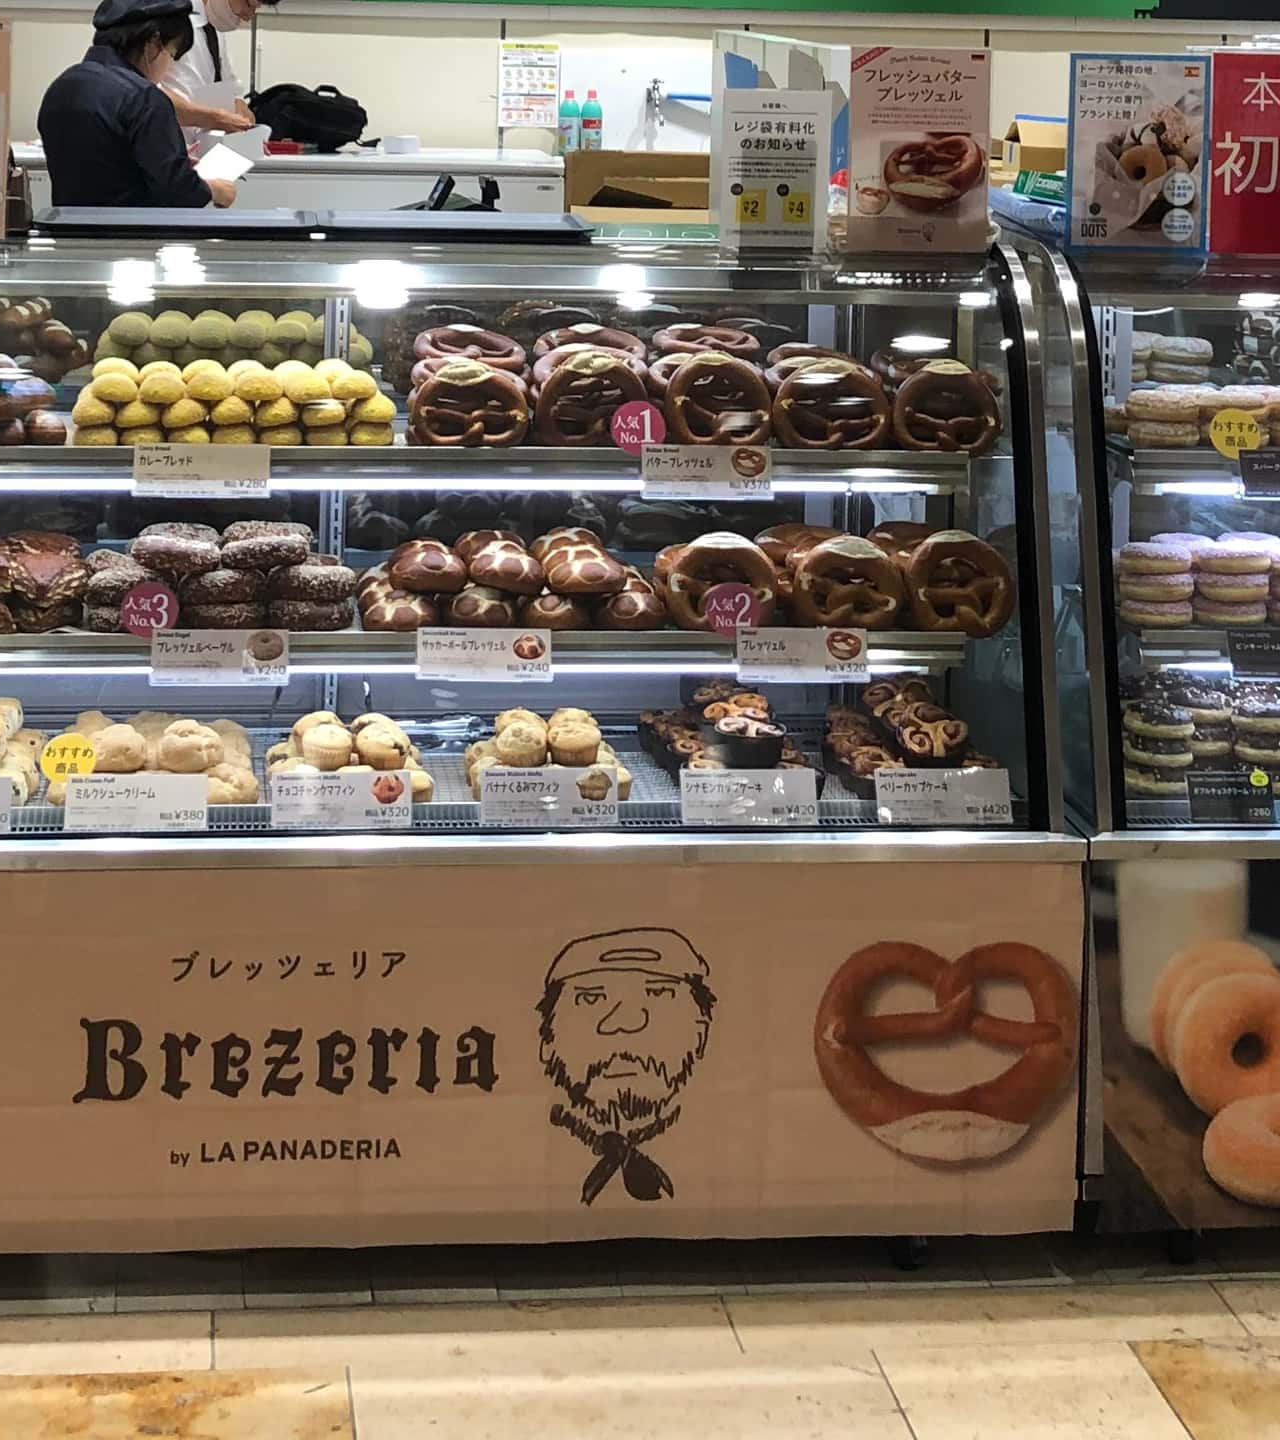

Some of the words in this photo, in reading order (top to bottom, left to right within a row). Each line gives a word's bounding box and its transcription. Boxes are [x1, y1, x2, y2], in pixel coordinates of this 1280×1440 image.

[864, 69, 977, 85] フレッシュバター
[877, 86, 963, 102] ブレッツェル
[734, 121, 815, 135] レジ袋有料化
[740, 138, 807, 151] のお知らせ
[1081, 224, 1107, 238] DOTS
[614, 416, 640, 429] 人気
[1225, 436, 1247, 448] 商品
[242, 477, 267, 488] ¥280
[743, 479, 770, 490] ¥370
[125, 597, 152, 611] 人気
[709, 596, 735, 612] 人気
[521, 662, 549, 673] ¥240
[839, 663, 867, 674] ¥320
[46, 746, 93, 759] おすすめ
[56, 762, 78, 773] 商品
[75, 787, 156, 799] ミルクシュークリーム
[174, 810, 204, 822] ¥380
[380, 807, 409, 818] ¥320
[587, 804, 615, 816] ¥320
[171, 950, 407, 983] ブレッツェリア
[72, 1017, 500, 1104] Brezeria
[170, 1149, 191, 1167] by
[200, 1141, 236, 1163] LA
[243, 1137, 402, 1162] PANADERIA
